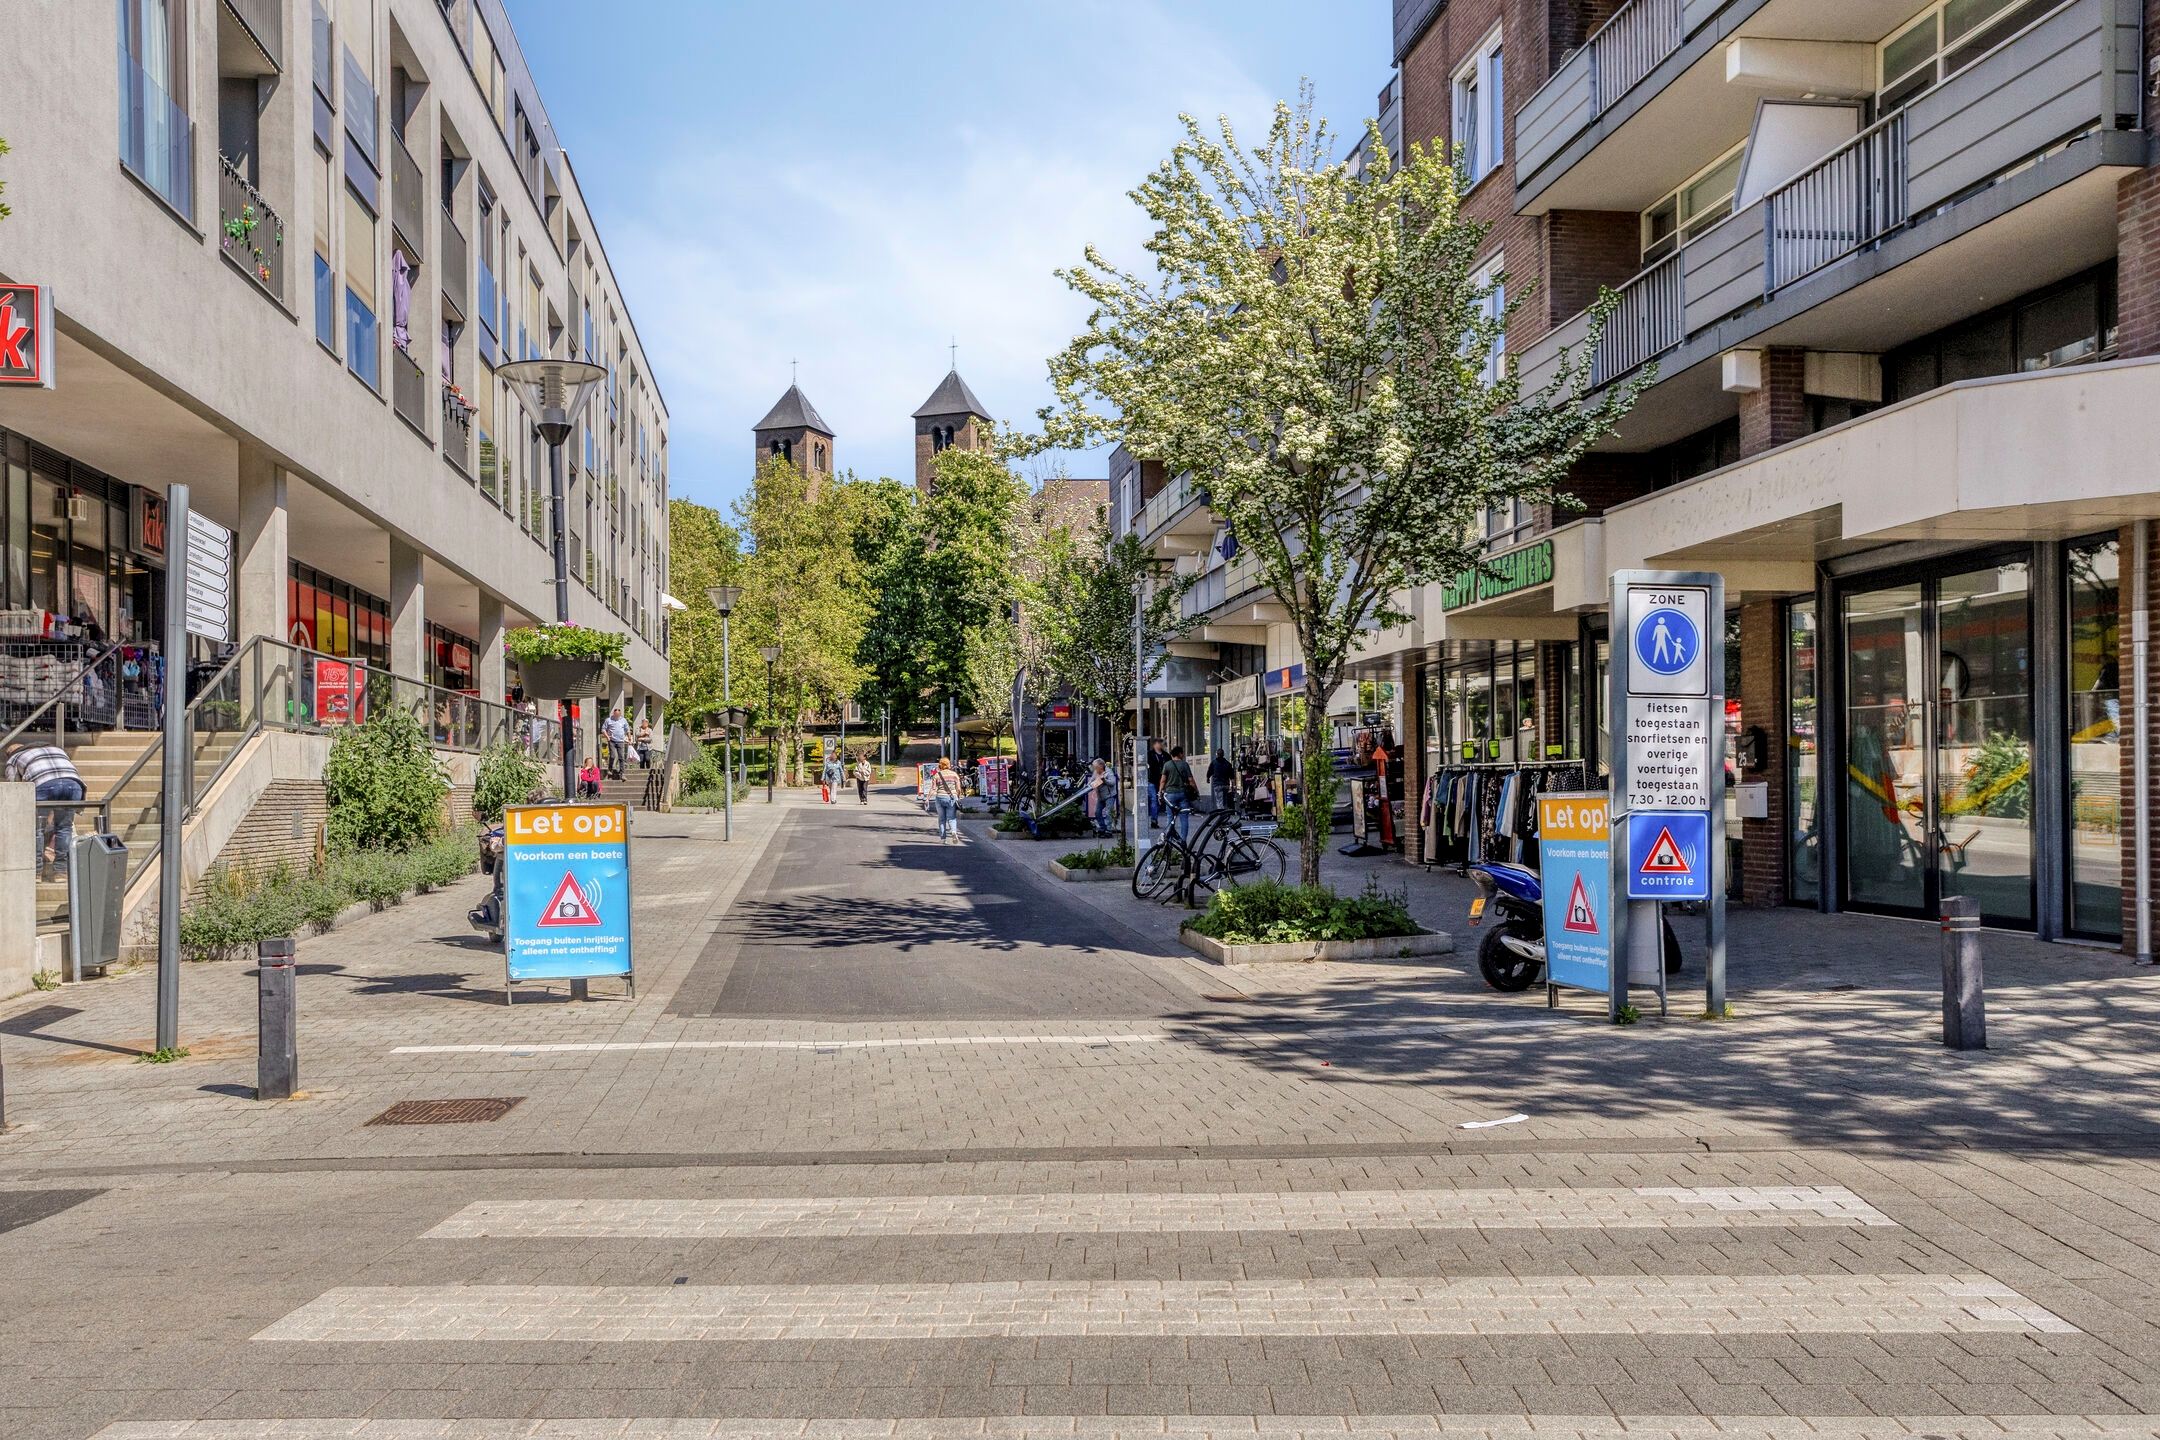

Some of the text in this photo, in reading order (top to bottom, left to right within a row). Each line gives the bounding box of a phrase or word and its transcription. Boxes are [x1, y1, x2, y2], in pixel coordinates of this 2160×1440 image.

[1442, 539, 1554, 612] HAPPY SCREAMERS
[1649, 594, 1685, 605] ZONE
[1647, 702, 1688, 714] fietsen
[1635, 718, 1700, 731] toegestaan
[1627, 733, 1708, 745] snorfietsen en
[1647, 748, 1688, 761] overige
[1738, 751, 1747, 767] 25
[1637, 764, 1698, 777] voertuigen
[1636, 779, 1699, 792] toegestaan
[1629, 794, 1654, 806] 7.30
[1665, 794, 1696, 806] 12.00
[1699, 794, 1706, 806] h
[514, 810, 622, 837] Let op!
[1545, 803, 1609, 834] Let op!
[514, 850, 623, 861] Voorkom een boete
[1546, 847, 1577, 857] Voorkom
[1577, 850, 1589, 858] een
[1641, 875, 1694, 886] controle
[515, 935, 624, 946] Toegang buiten inrijtijden
[1552, 940, 1574, 951] Toegang
[522, 947, 549, 955] alleen
[570, 945, 617, 955] ontheffing!
